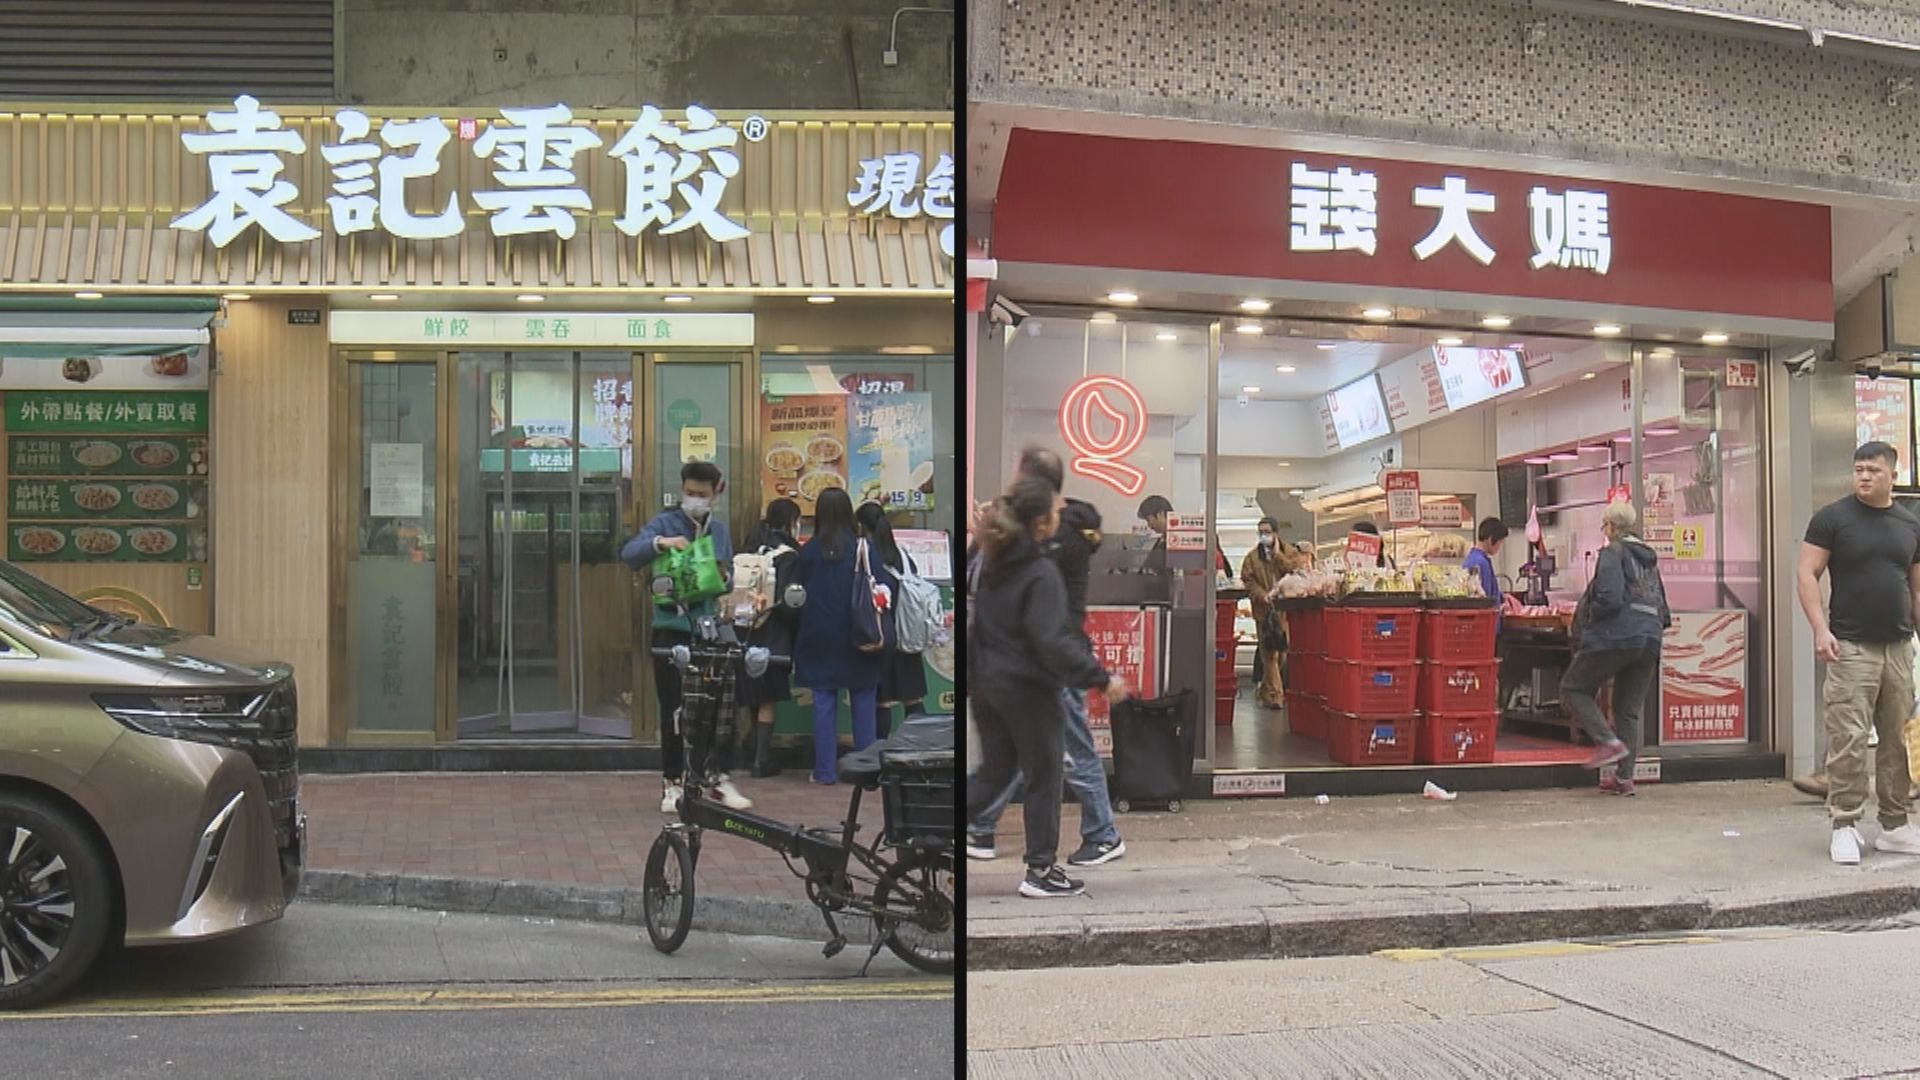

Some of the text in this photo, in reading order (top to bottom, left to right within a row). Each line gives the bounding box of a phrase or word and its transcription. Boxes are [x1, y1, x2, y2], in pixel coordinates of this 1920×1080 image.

[171, 94, 750, 248] 袁記雲餃
[1290, 161, 1611, 275] 錢大媽
[424, 318, 672, 339] 鮮餃 雲吞 面食
